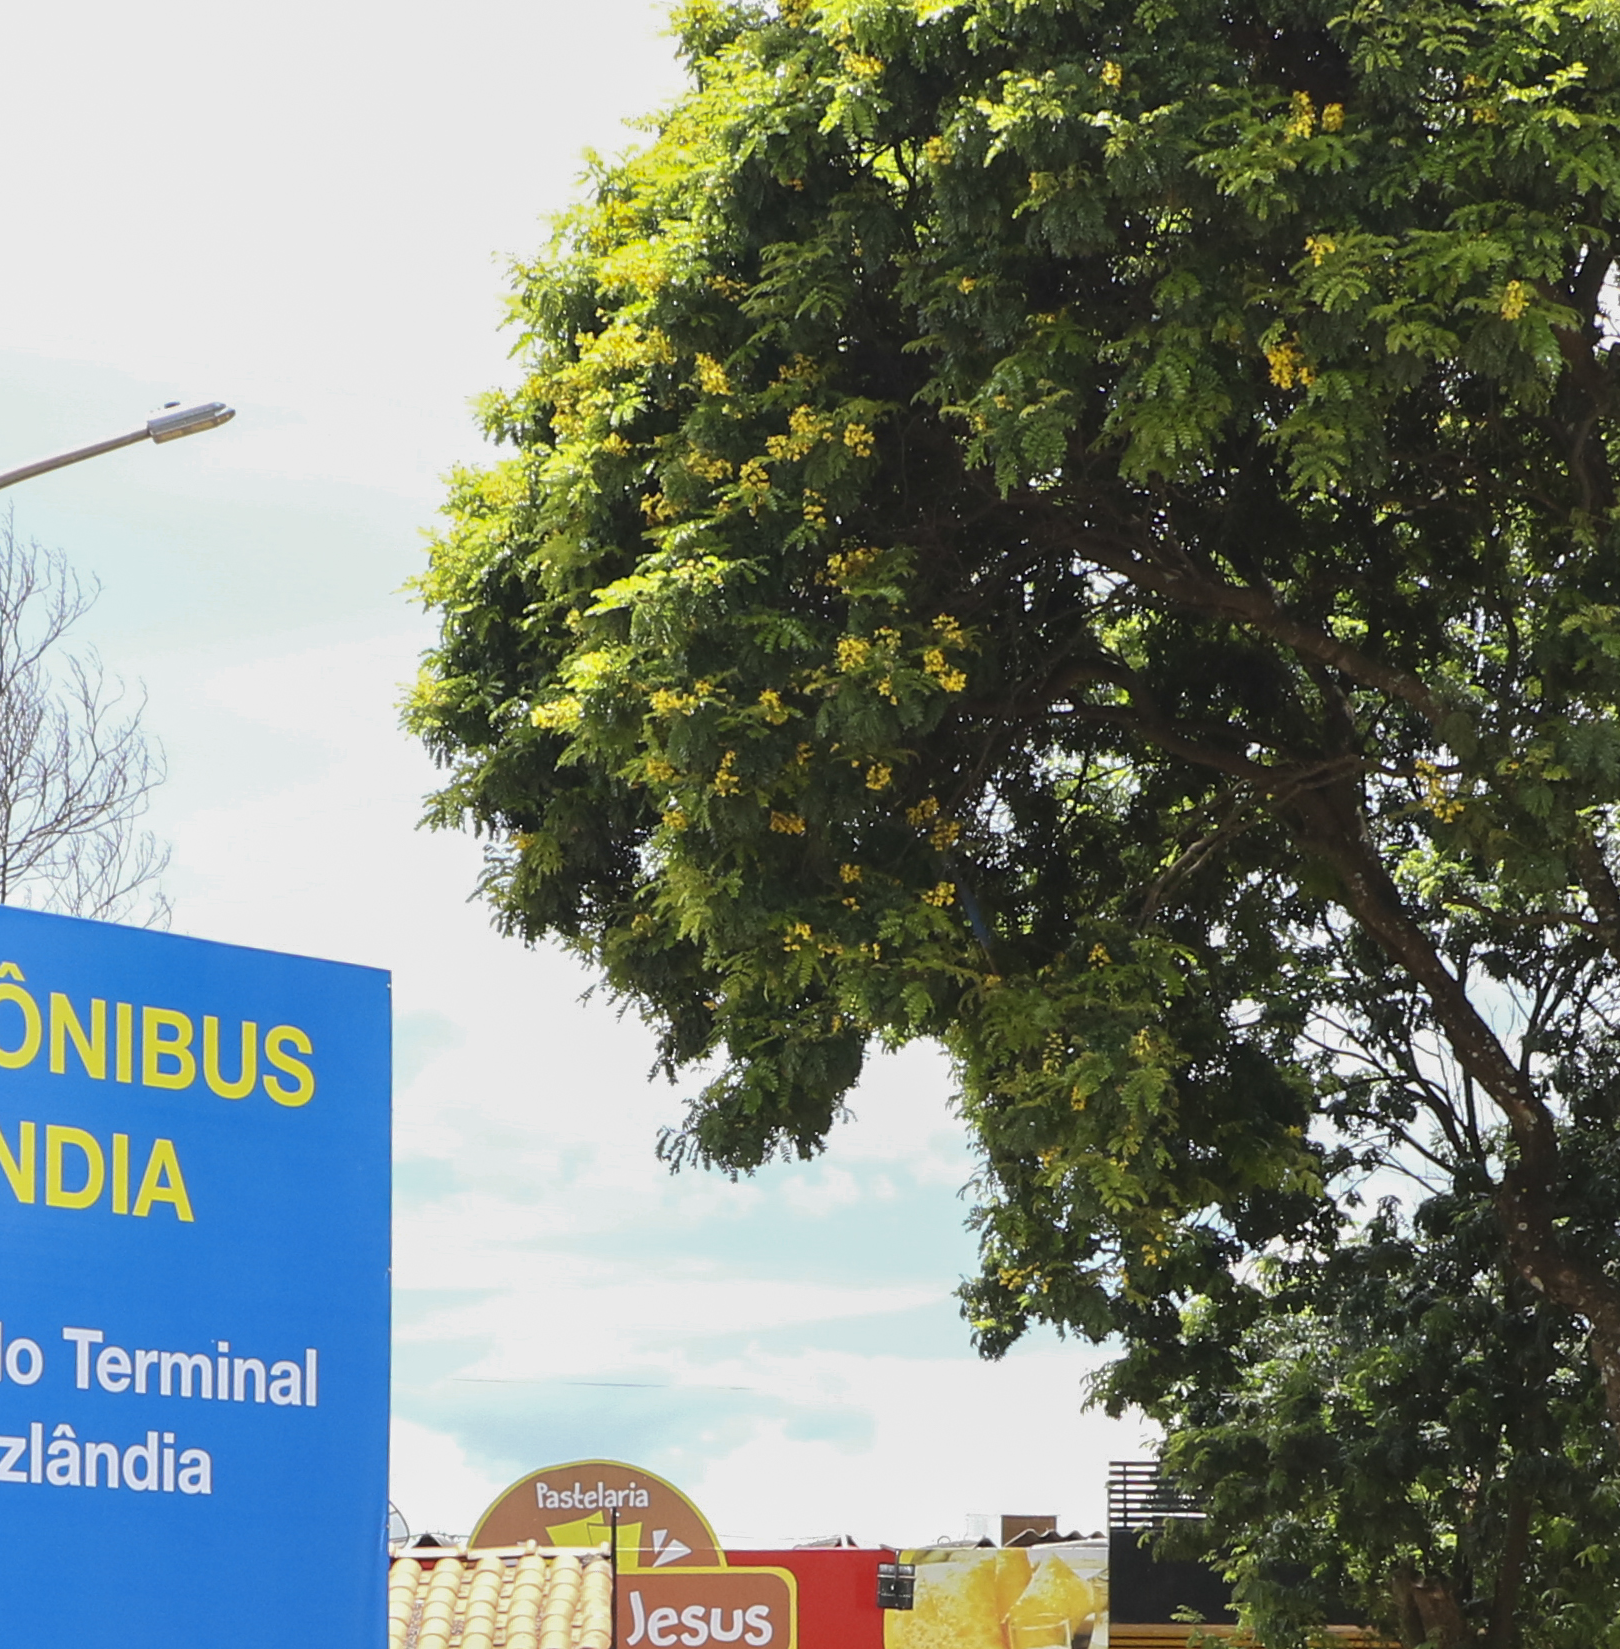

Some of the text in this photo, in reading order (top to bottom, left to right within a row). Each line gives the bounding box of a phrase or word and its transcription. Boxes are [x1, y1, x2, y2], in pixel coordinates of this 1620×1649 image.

[64, 1329, 318, 1408] Terminal
[535, 1481, 650, 1509] Pastelaria
[626, 1589, 775, 1648] Jesus
